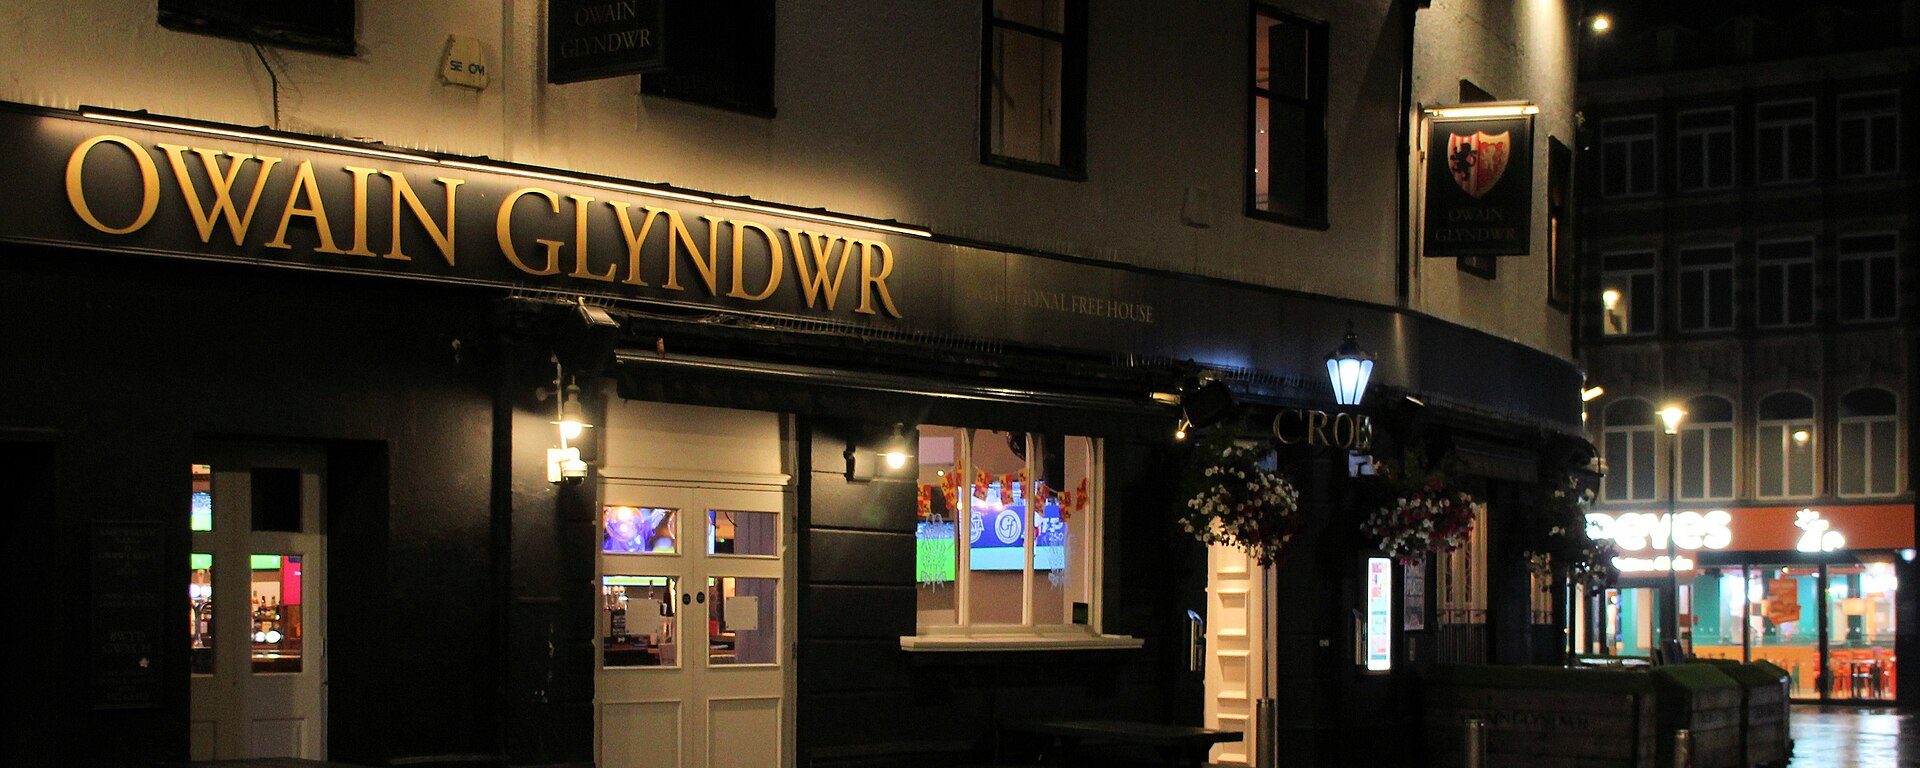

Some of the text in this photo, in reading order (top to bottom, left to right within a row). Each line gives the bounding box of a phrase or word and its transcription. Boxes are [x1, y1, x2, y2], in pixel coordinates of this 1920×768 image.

[575, 0, 636, 27] OWAIN
[561, 28, 653, 58] GLYNDWR
[65, 134, 902, 319] OWAIN GLYNDWR
[1448, 206, 1502, 222] OWAIN
[1435, 227, 1516, 243] GLYNDWR
[1071, 295, 1104, 316] FREE
[1106, 298, 1155, 324] HOUSE
